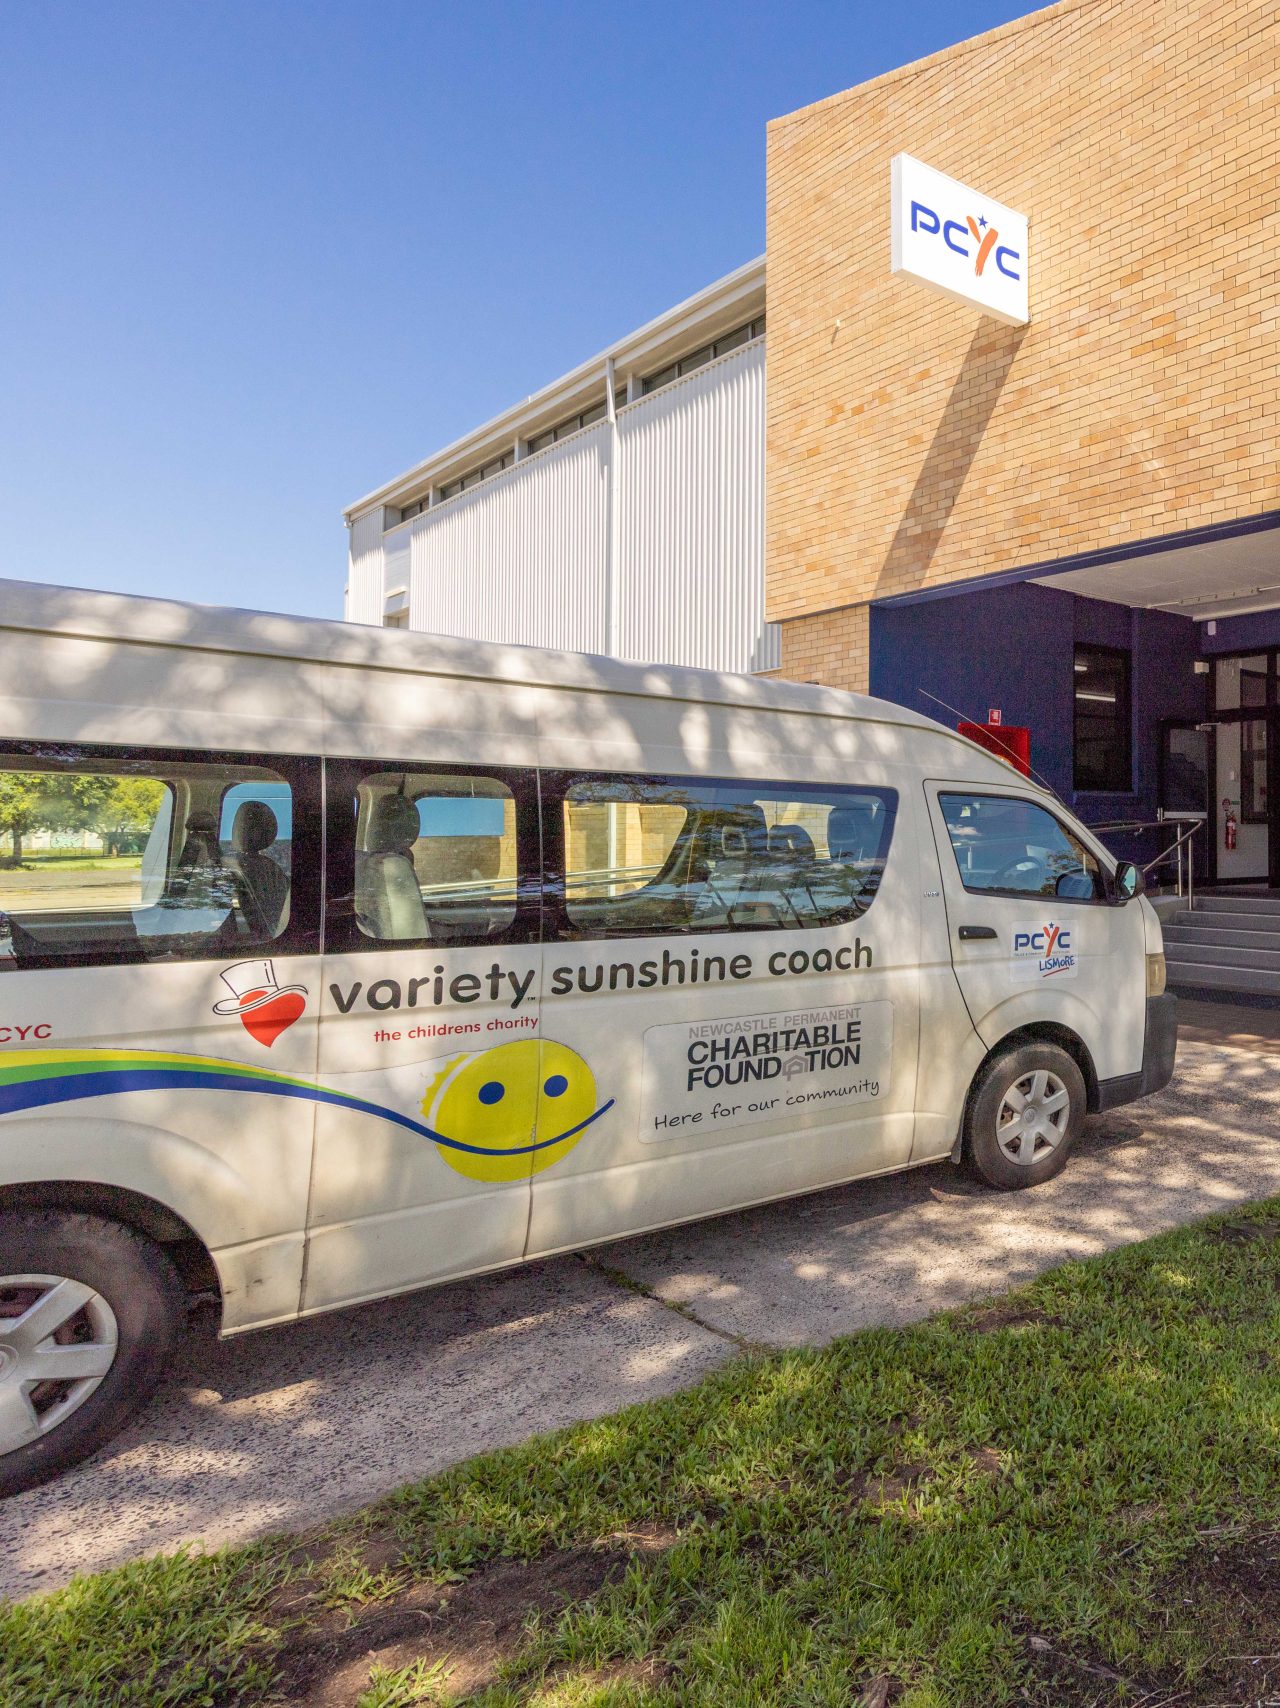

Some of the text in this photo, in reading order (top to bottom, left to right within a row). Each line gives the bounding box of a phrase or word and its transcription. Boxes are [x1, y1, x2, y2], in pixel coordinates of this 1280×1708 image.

[911, 200, 1020, 281] PCYC
[1014, 926, 1071, 957] PCYC
[329, 963, 536, 1014] variety
[551, 948, 753, 995] sunshine
[768, 937, 873, 976] coach
[374, 1015, 539, 1042] the childrens charity
[687, 1021, 862, 1065] CHARITABLE
[688, 1007, 861, 1039] NEWCASTLE PERMANENT
[654, 1079, 880, 1130] Here for our community
